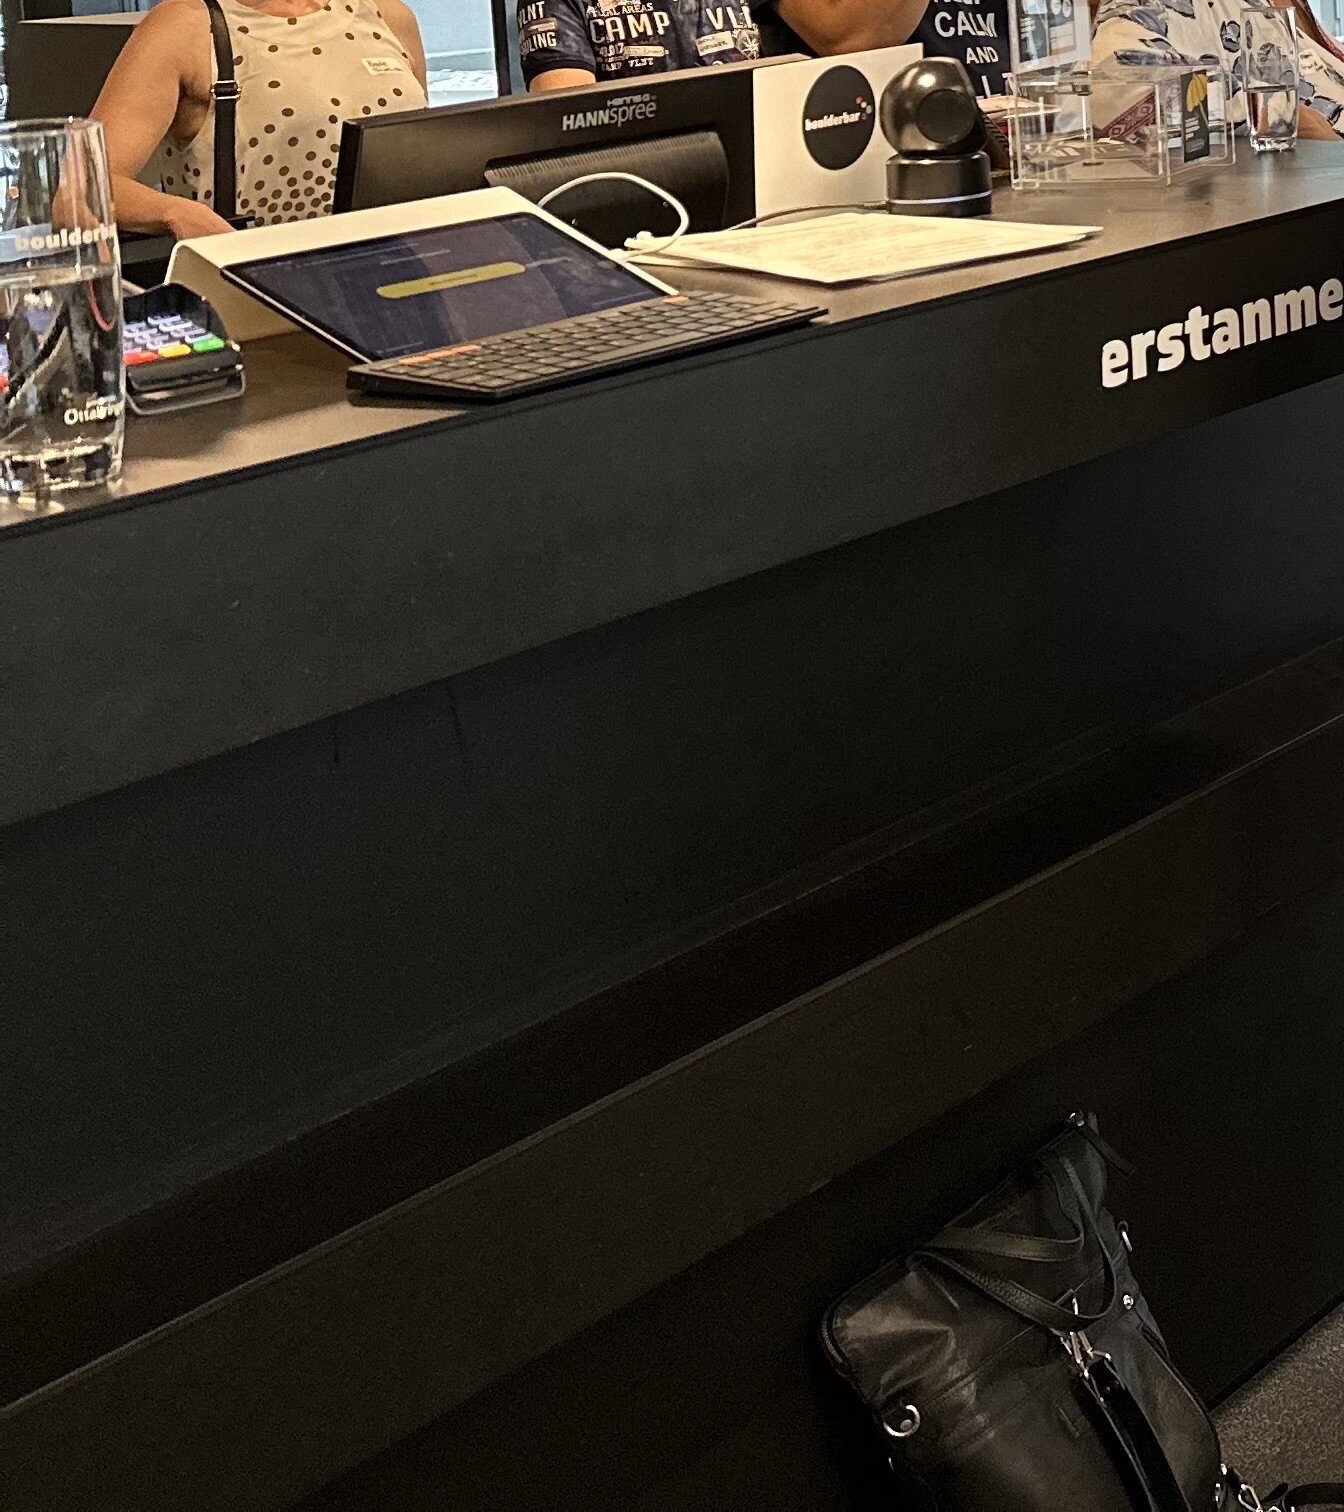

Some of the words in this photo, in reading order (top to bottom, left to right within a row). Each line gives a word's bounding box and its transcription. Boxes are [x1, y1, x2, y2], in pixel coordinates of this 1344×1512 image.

[590, 11, 671, 44] CAMP
[934, 10, 998, 38] CALM
[966, 46, 999, 65] AND
[562, 101, 657, 131] HANNspree
[805, 111, 861, 132] boulderbar
